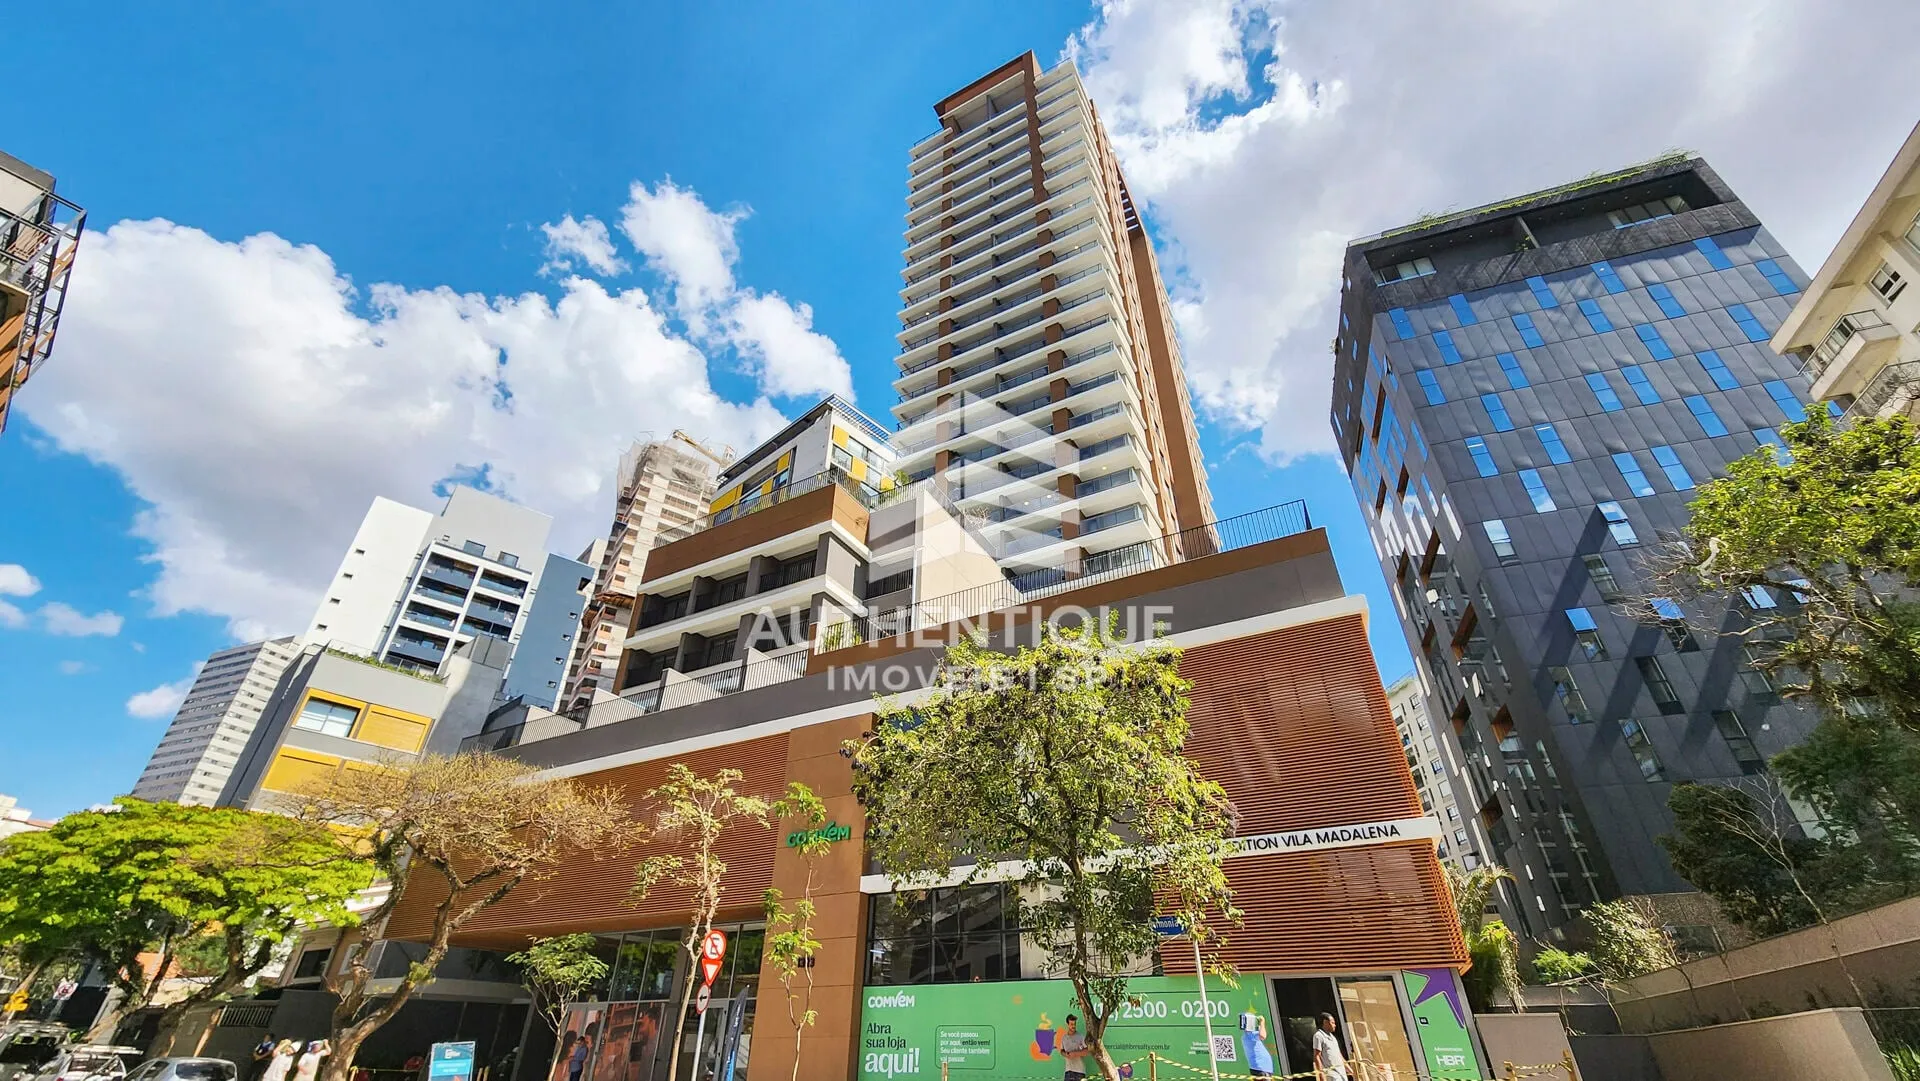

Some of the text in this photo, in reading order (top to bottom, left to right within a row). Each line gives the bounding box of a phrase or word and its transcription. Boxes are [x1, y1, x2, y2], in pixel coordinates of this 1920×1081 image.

[1281, 832, 1314, 847] VILA
[1316, 824, 1401, 844] MADALENA
[1122, 1001, 1167, 1019] 2500
[1181, 1000, 1230, 1018] 0200
[867, 1023, 891, 1034] Abra
[866, 1037, 906, 1050] sua loja
[865, 1048, 920, 1079] aqui!
[1436, 1055, 1465, 1066] HBR
